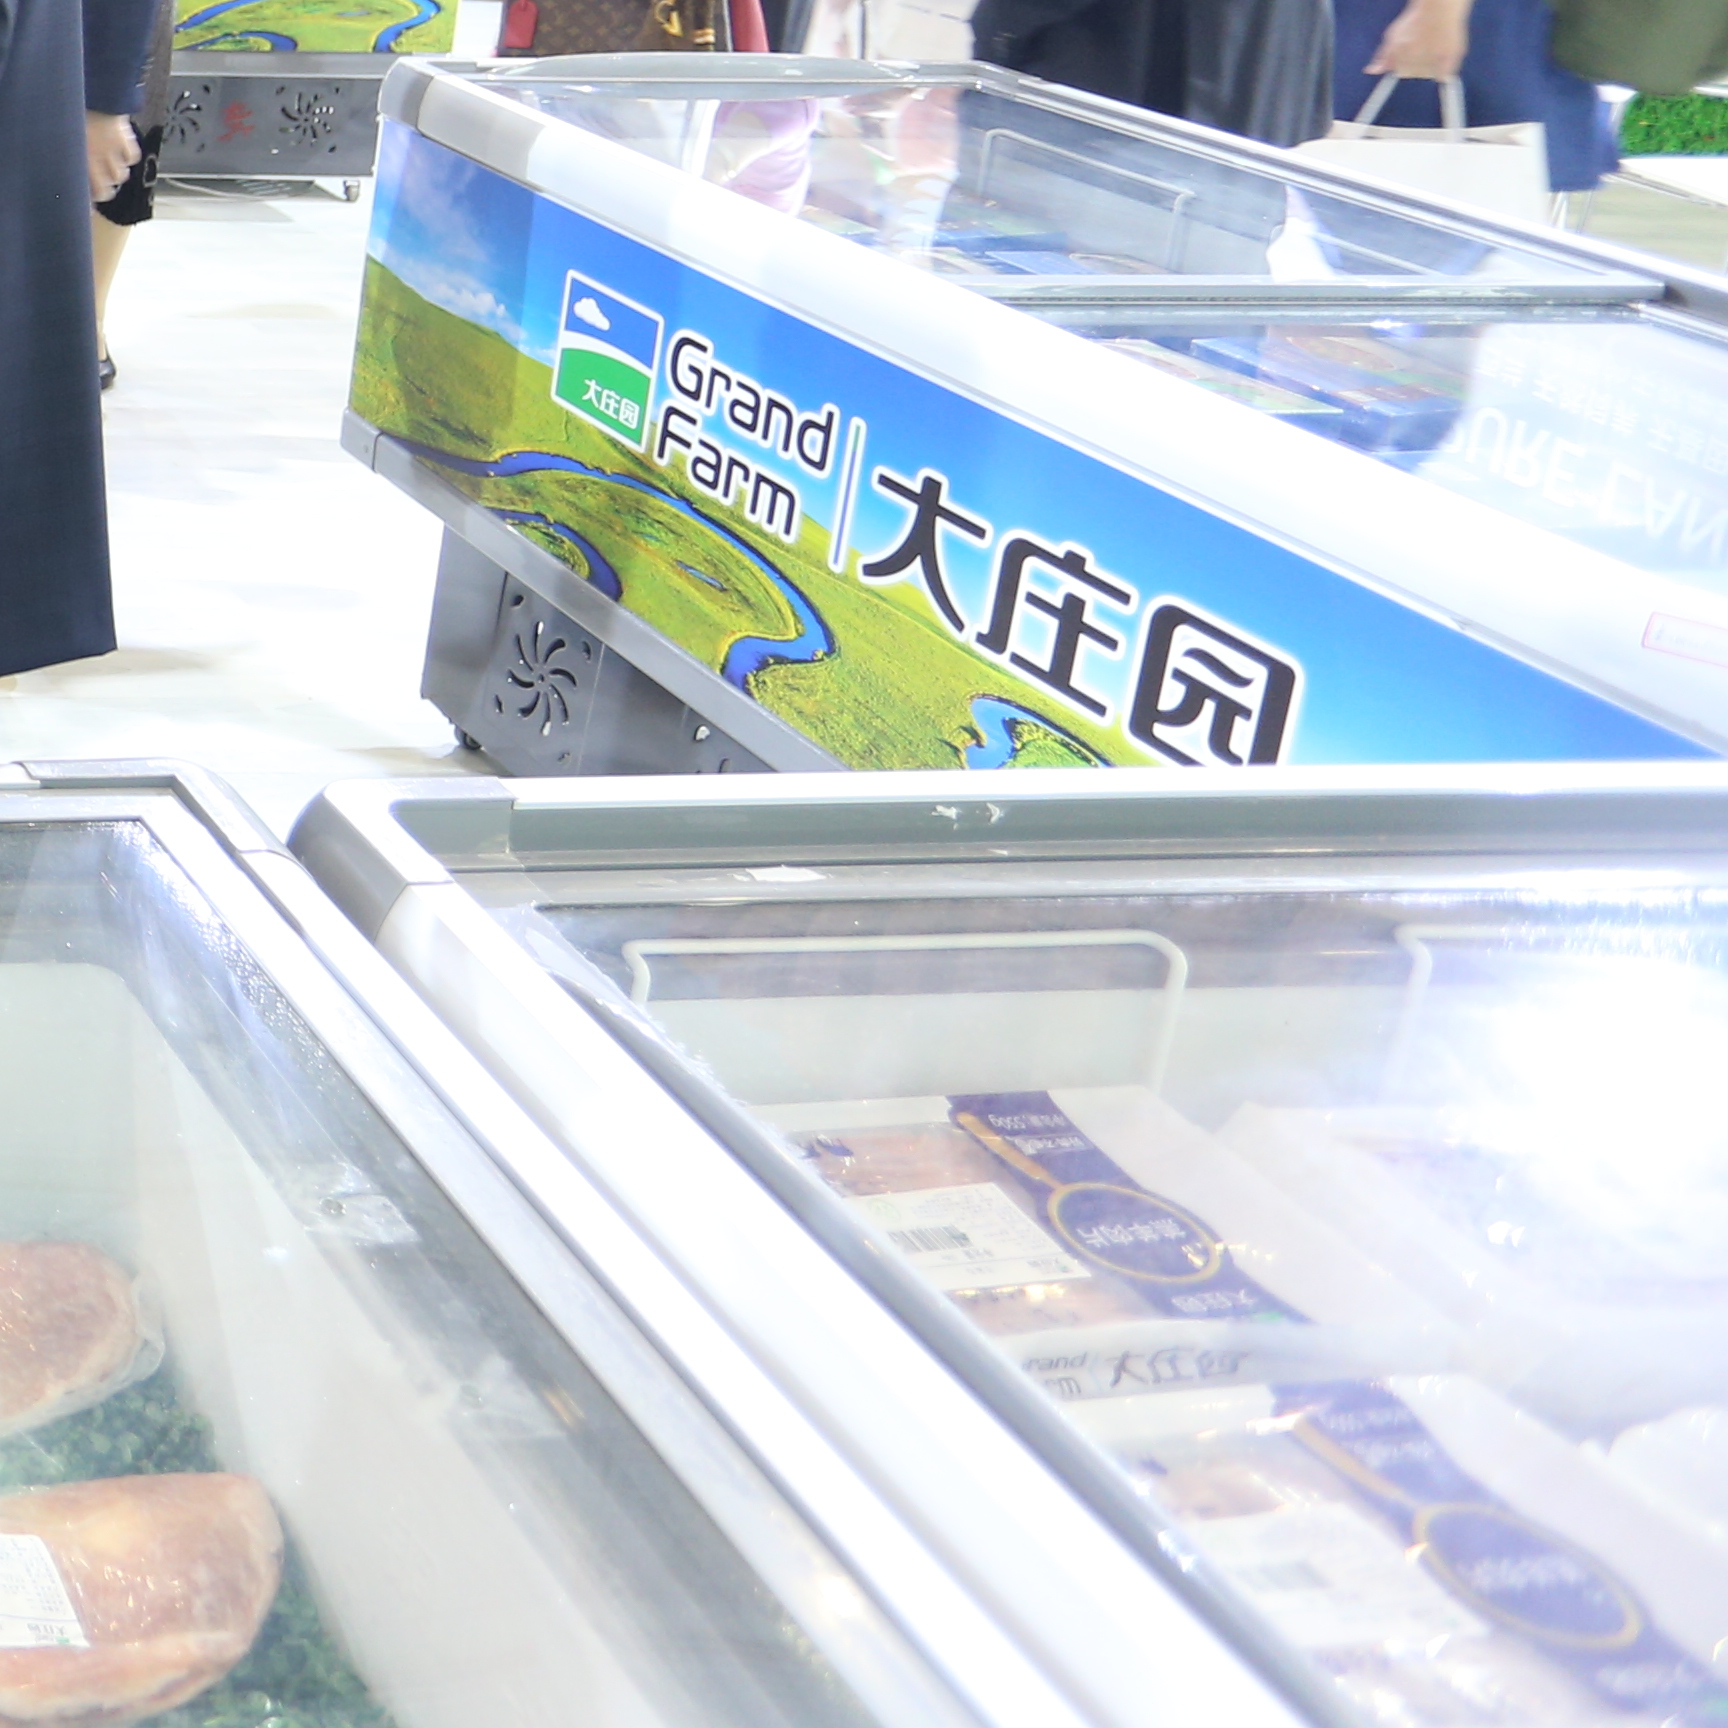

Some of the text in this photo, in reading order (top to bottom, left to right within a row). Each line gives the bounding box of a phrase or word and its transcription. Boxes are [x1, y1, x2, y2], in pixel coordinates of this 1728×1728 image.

[584, 379, 640, 427] 大庄园
[670, 336, 834, 472] Grand
[656, 406, 796, 537] Farm
[862, 471, 1295, 763] 大庄园
[1021, 1352, 1088, 1373] rand
